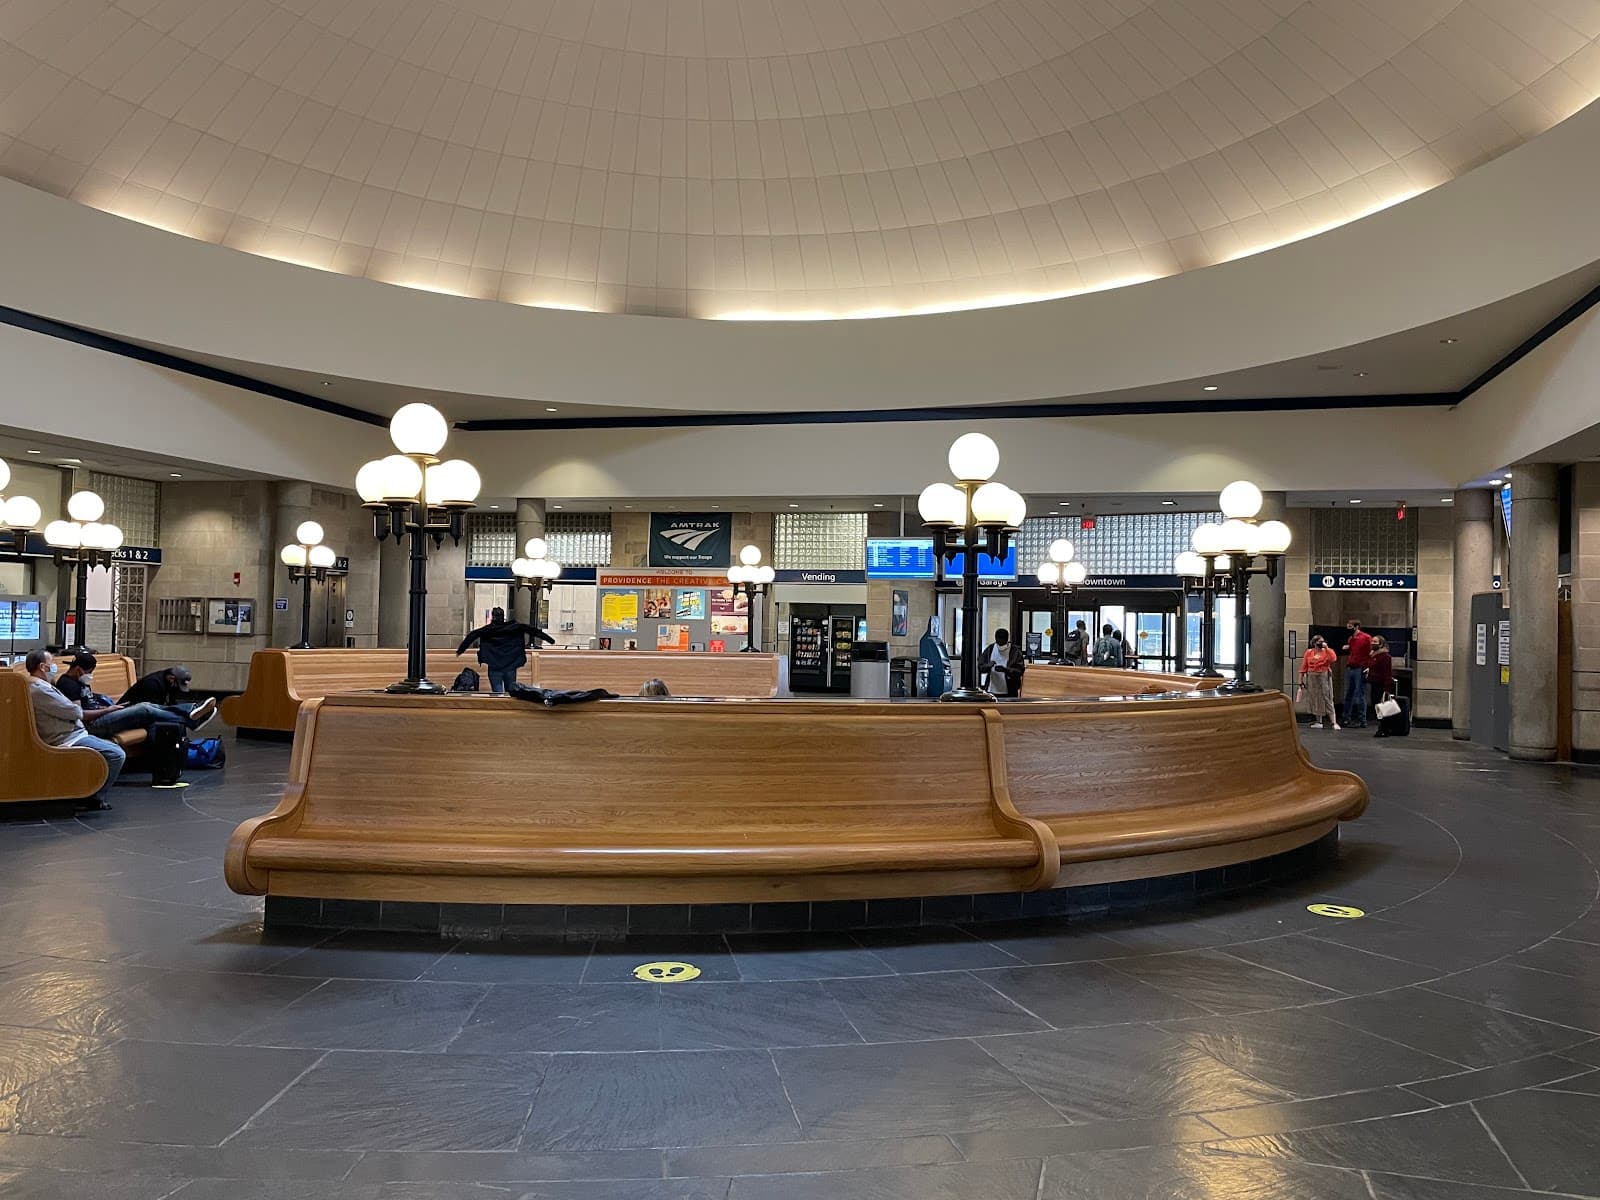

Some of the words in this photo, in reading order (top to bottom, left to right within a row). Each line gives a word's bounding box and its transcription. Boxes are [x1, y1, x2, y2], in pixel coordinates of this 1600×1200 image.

[129, 549, 133, 559] 1
[135, 550, 141, 560] &
[142, 551, 149, 560] 2
[801, 572, 836, 582] Vending
[1083, 578, 1126, 586] owntown
[1338, 577, 1393, 587] Restrooms
